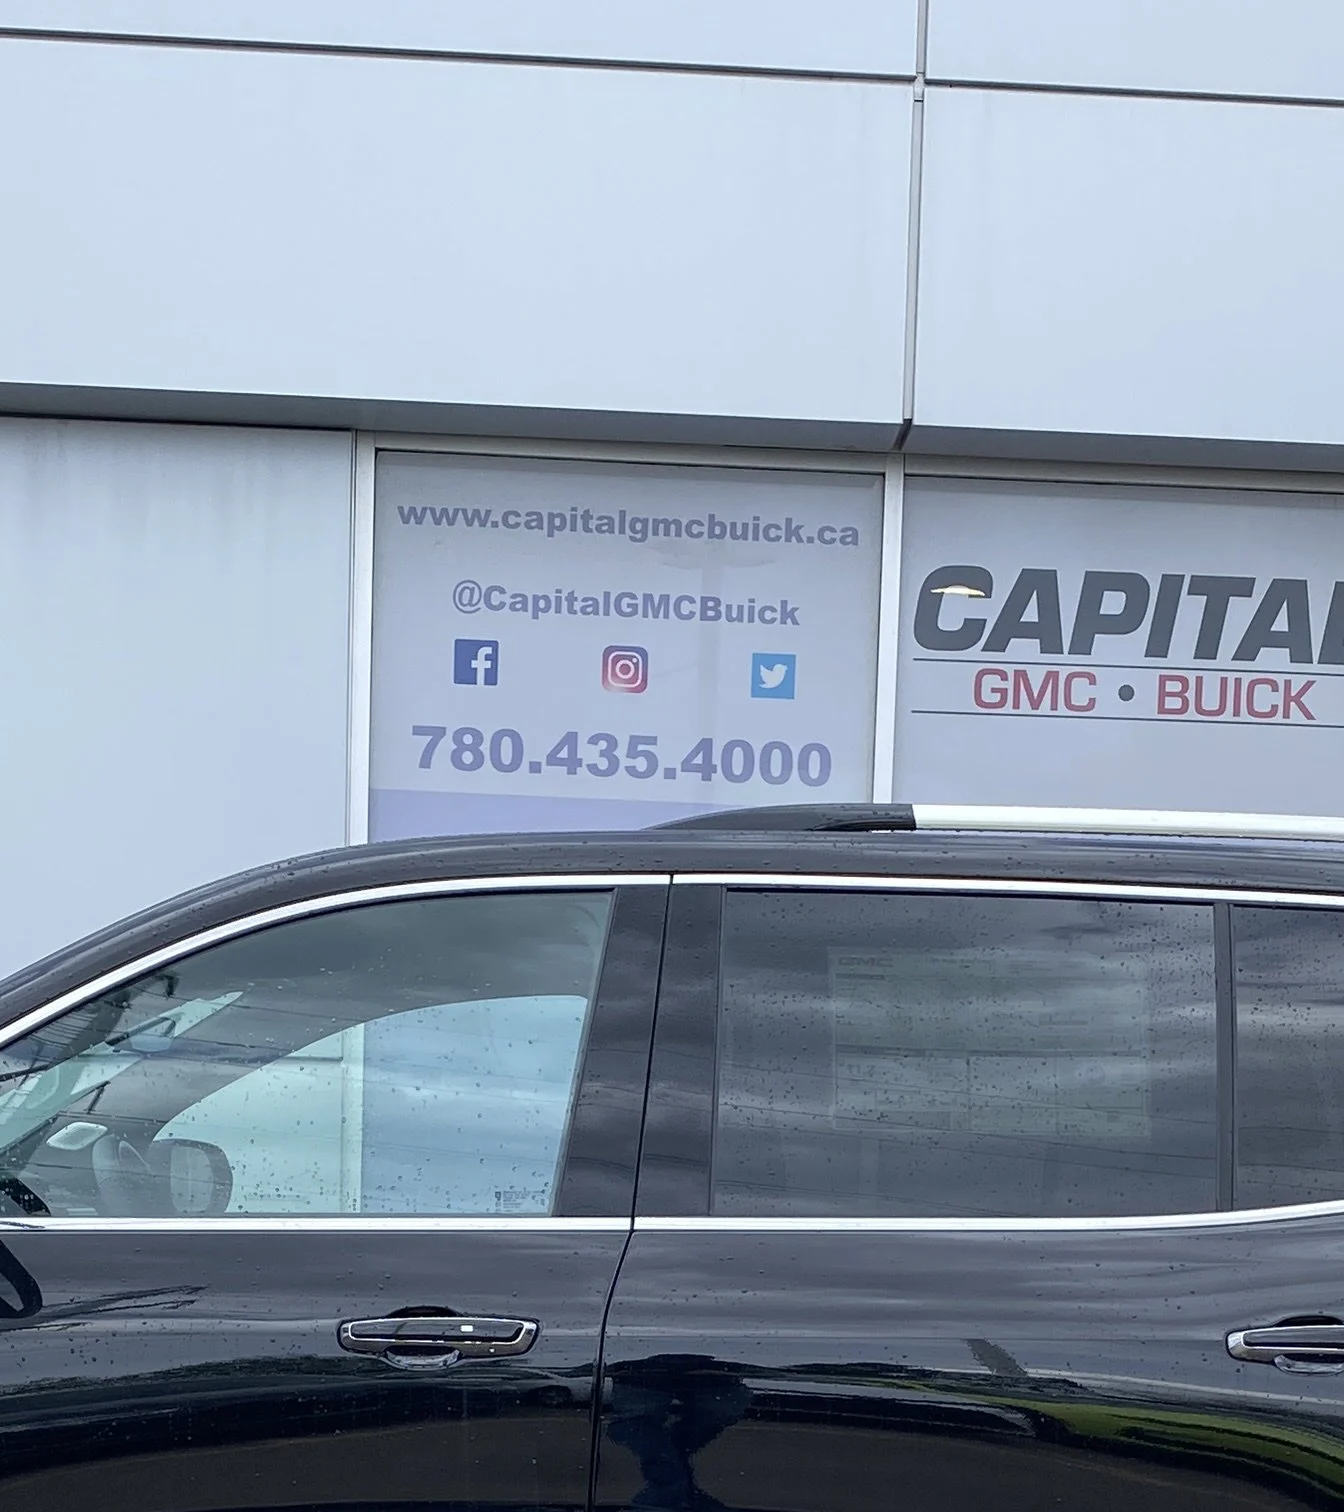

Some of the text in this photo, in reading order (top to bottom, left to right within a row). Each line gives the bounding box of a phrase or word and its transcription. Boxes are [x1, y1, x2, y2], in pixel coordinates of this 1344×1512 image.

[397, 505, 860, 546] www.capitalgmcbuick.ca
[452, 580, 800, 626] @CapitalGMCBuick
[973, 668, 1316, 720] GMC BUICK
[411, 725, 832, 787] 780.435.4000
